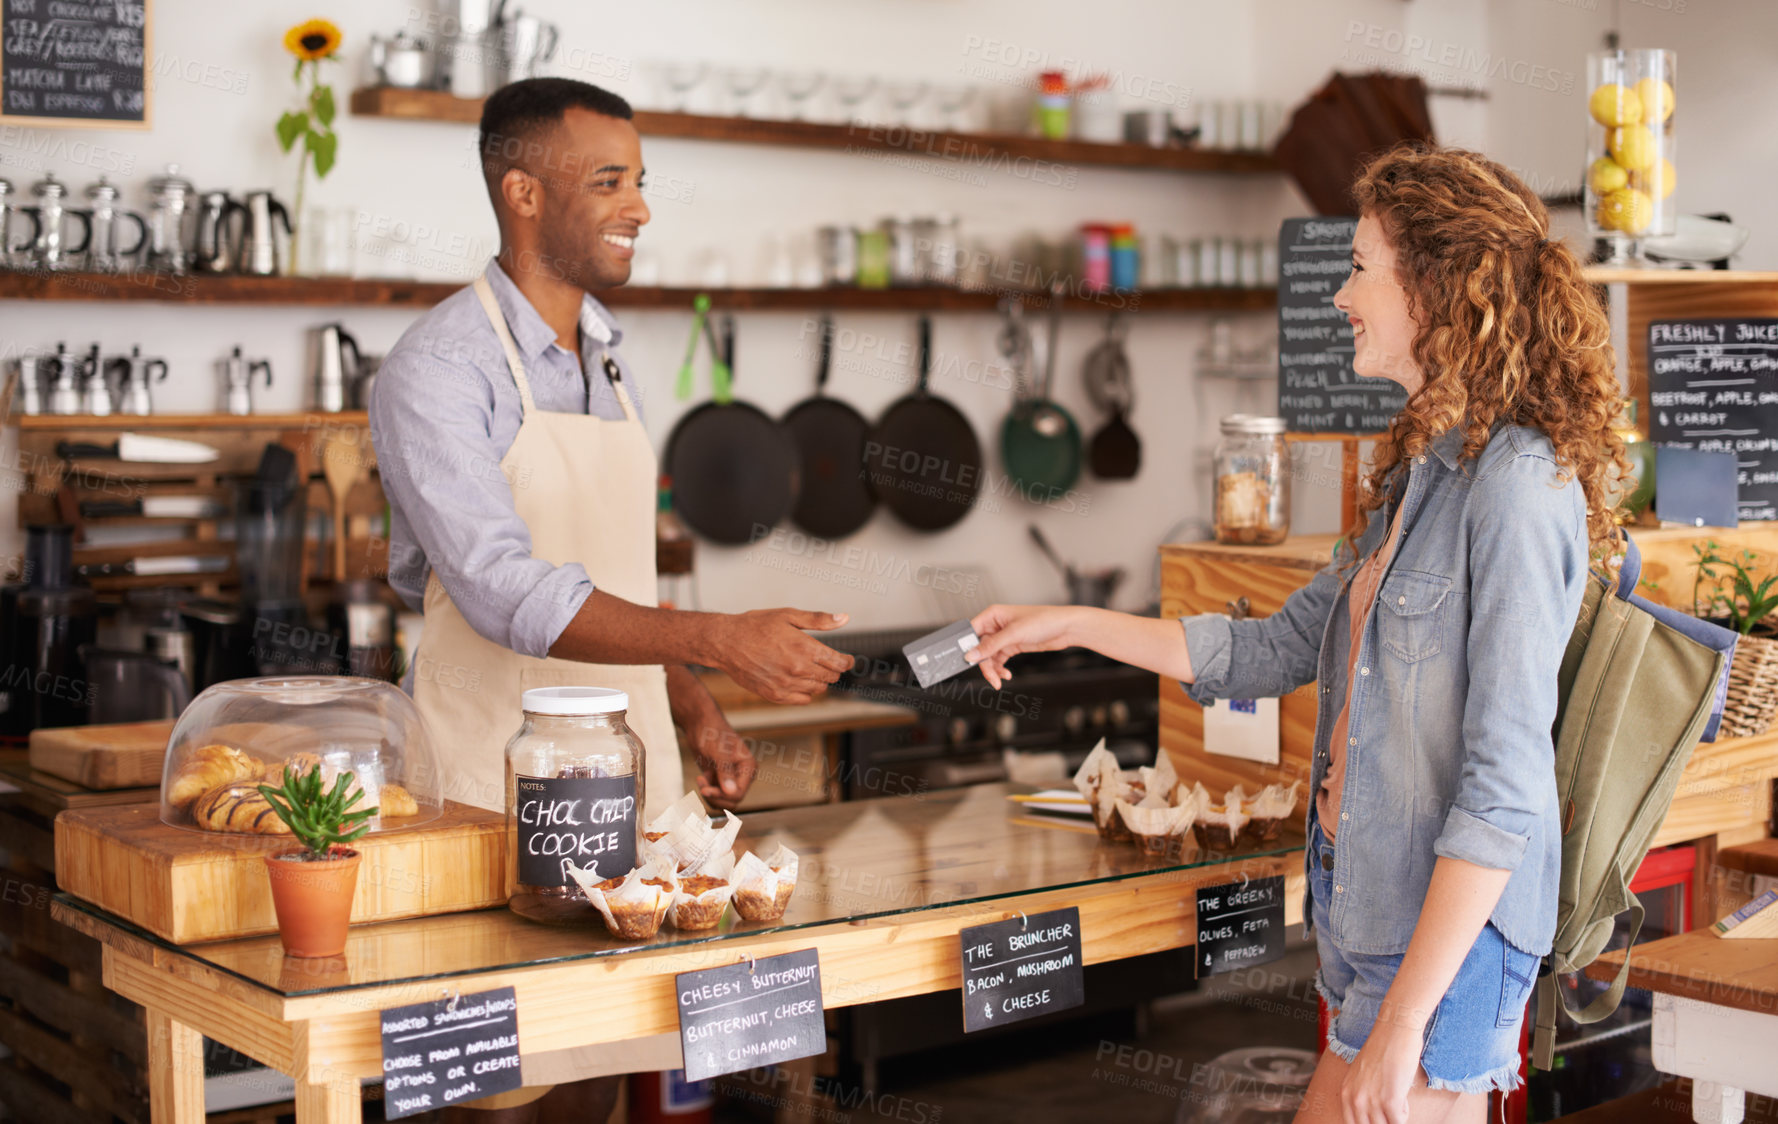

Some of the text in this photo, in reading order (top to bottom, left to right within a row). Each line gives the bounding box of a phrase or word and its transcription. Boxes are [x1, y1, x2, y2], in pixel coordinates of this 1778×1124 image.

[1651, 323, 1725, 344] FRESHLY
[1675, 412, 1728, 426] CARROT
[520, 782, 546, 791] NOTES:
[521, 795, 634, 826] CHOC CHIP
[528, 831, 619, 856] COOKIE
[1197, 887, 1273, 912] THE GREEKY
[1242, 918, 1269, 934] FETA
[965, 923, 1073, 963] THE BRUNCHER
[1224, 944, 1267, 962] PEPPADEW
[1017, 953, 1074, 977] MUSHROOM
[681, 964, 817, 1006] CHEESY BUTTERNUT
[1002, 989, 1051, 1013] CHEESE
[382, 1016, 429, 1034] ASSORTED
[686, 999, 816, 1043] BUTTERNUT, CHEESE
[383, 1034, 518, 1072] CHOOSE FROM AVAILABLE
[728, 1035, 797, 1061] CINNAMON
[386, 1054, 520, 1091] OPTIONS OR CREATE
[394, 1093, 432, 1112] YOUR
